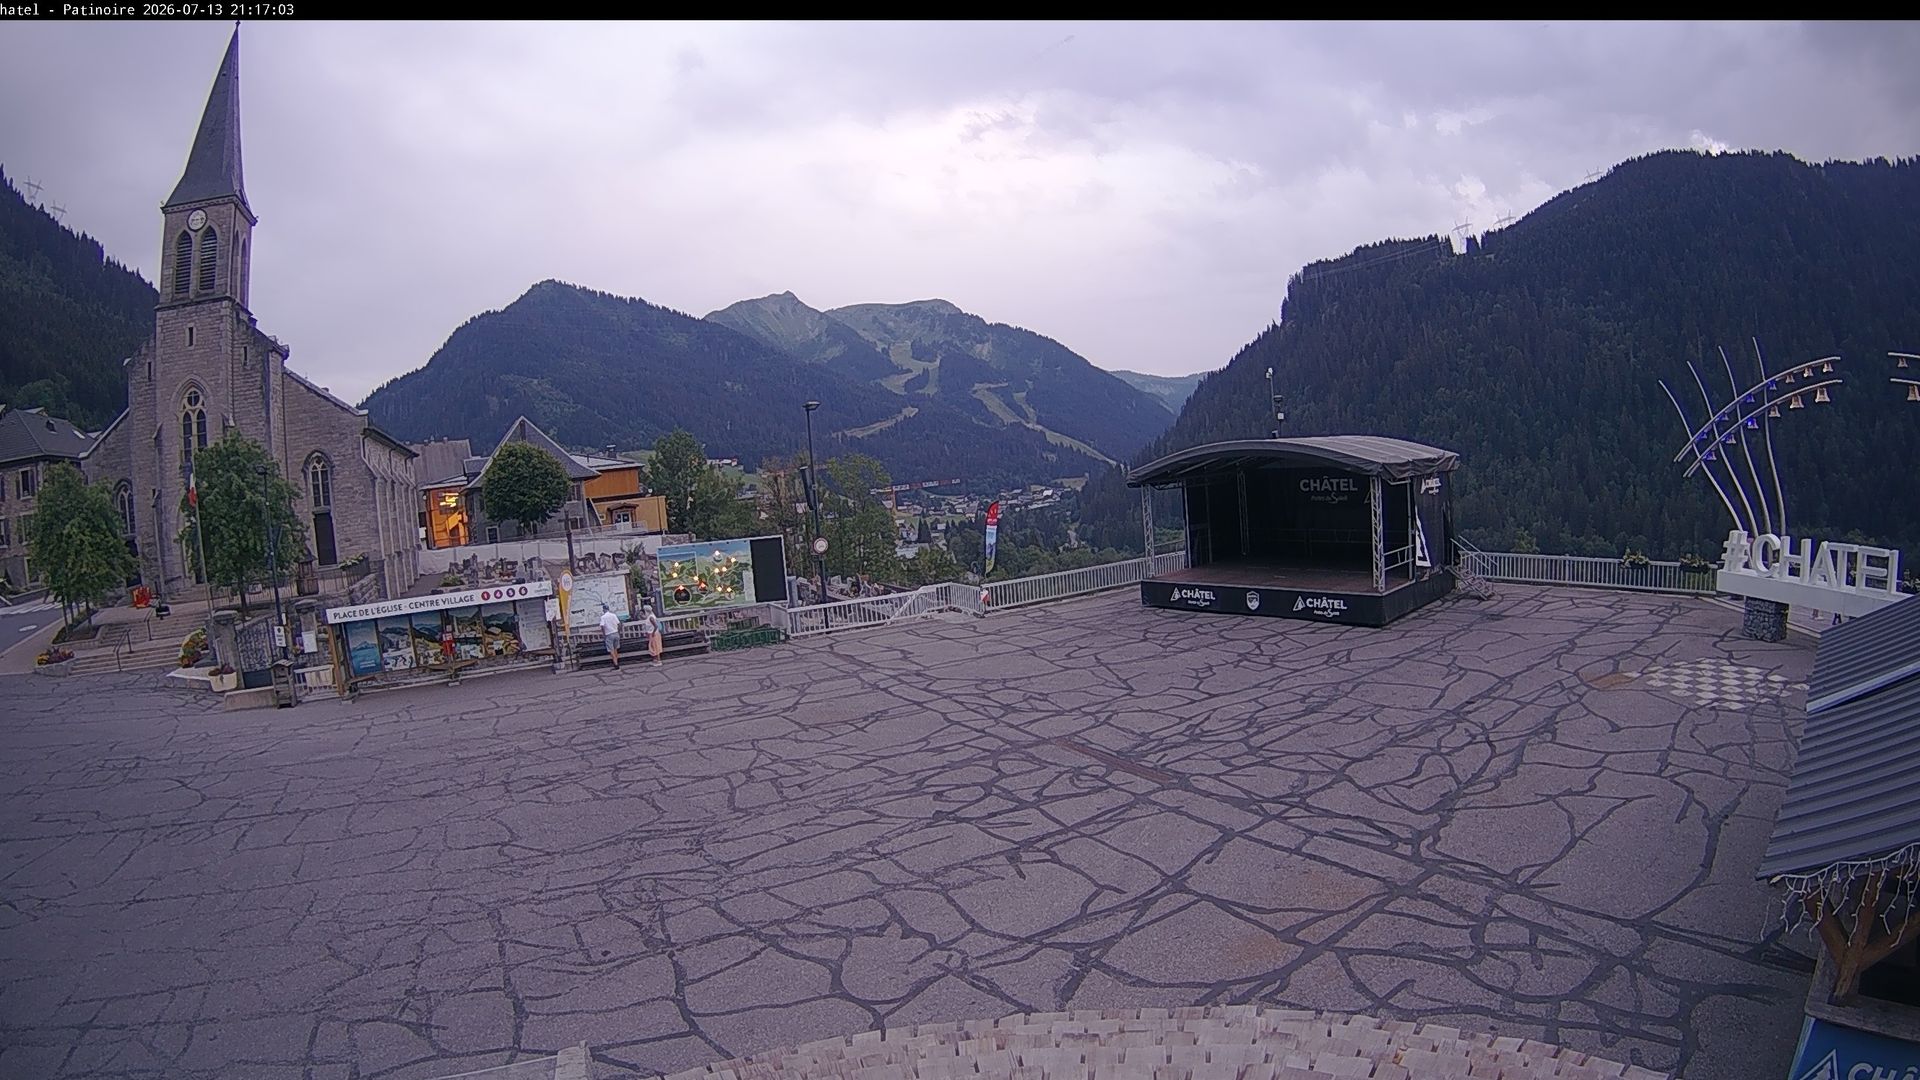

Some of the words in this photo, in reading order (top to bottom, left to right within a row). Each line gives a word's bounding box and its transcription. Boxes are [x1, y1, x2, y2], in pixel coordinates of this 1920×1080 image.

[1300, 475, 1358, 491] CHÂTEL
[1181, 588, 1216, 600] CHÂTEL
[333, 610, 358, 621] PLACE
[358, 608, 370, 617] DE
[370, 603, 404, 616] L'ÉGLISE
[408, 598, 440, 610] CENTRE
[440, 594, 475, 606] VILLAGE
[1305, 596, 1348, 610] CHÂTEL
